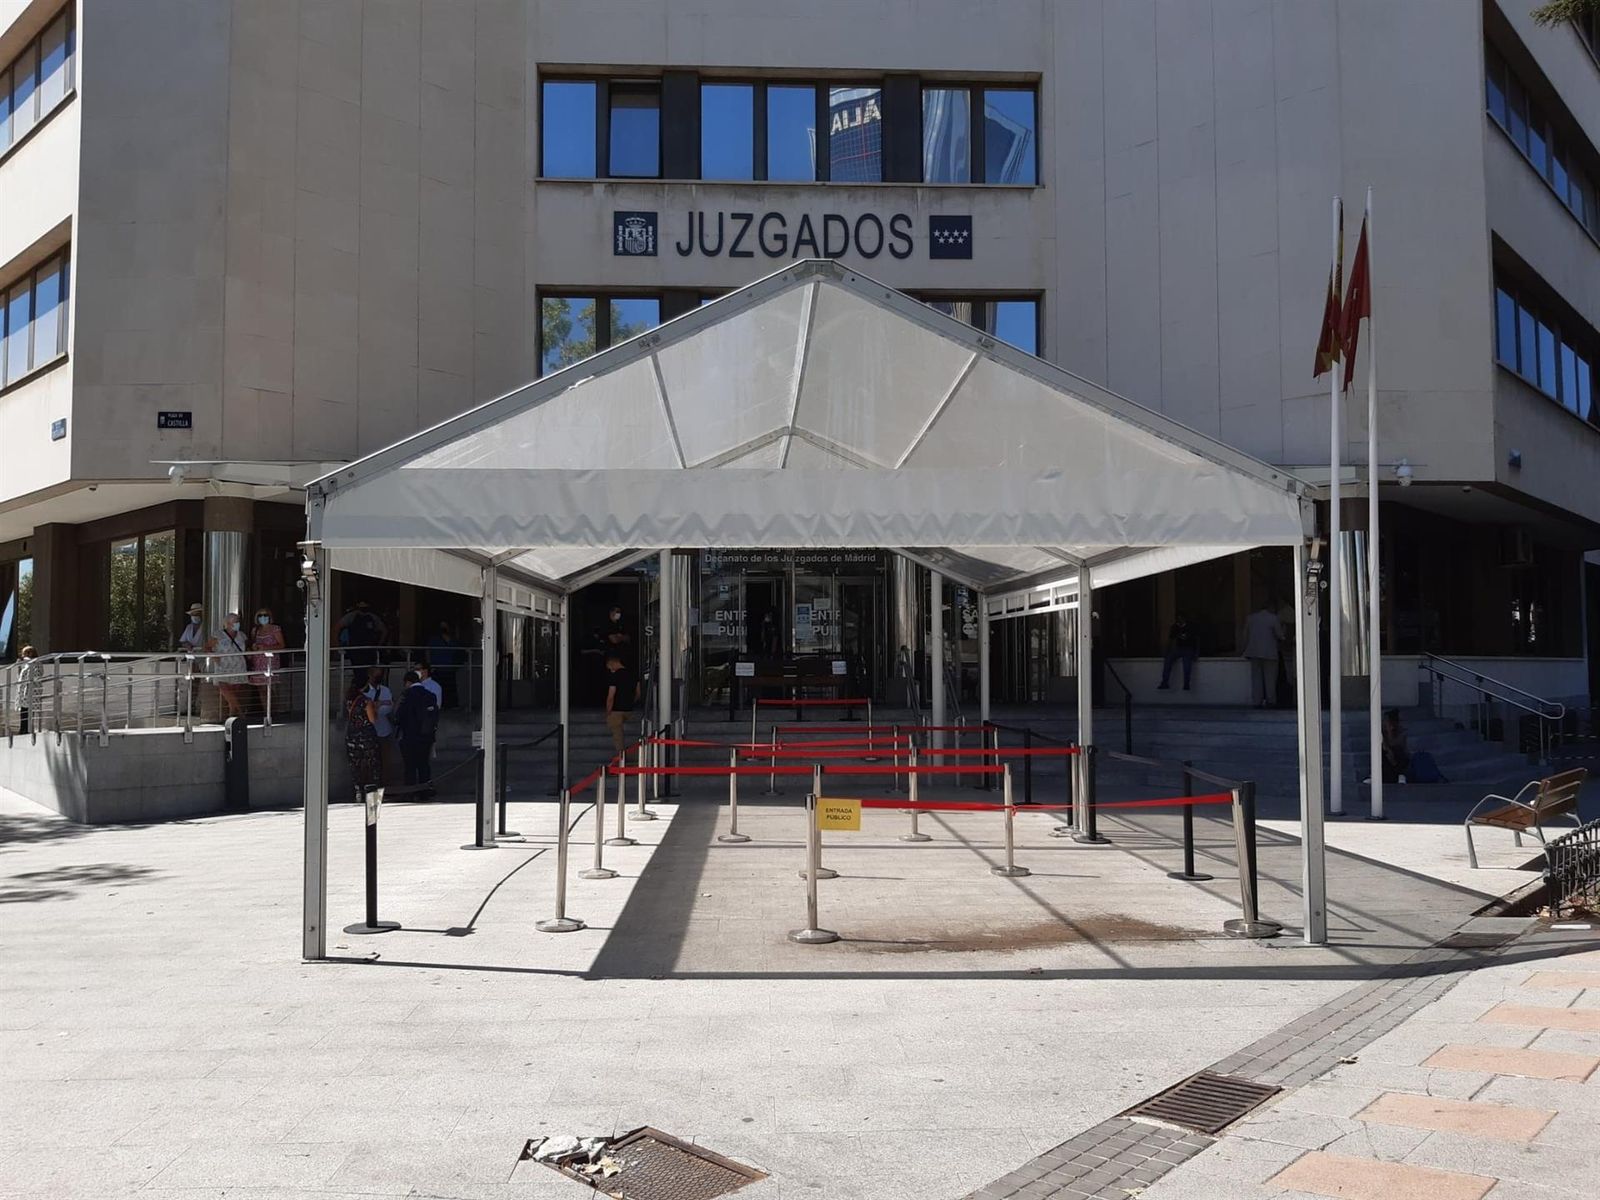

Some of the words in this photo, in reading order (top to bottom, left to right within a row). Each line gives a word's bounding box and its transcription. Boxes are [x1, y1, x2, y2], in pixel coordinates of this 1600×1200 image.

[676, 211, 914, 259] JUZGADOS
[705, 554, 748, 563] Decanato
[750, 554, 762, 563] de
[764, 554, 779, 563] los
[781, 554, 828, 565] Juzgados
[830, 554, 842, 563] de
[844, 554, 876, 563] Madrid
